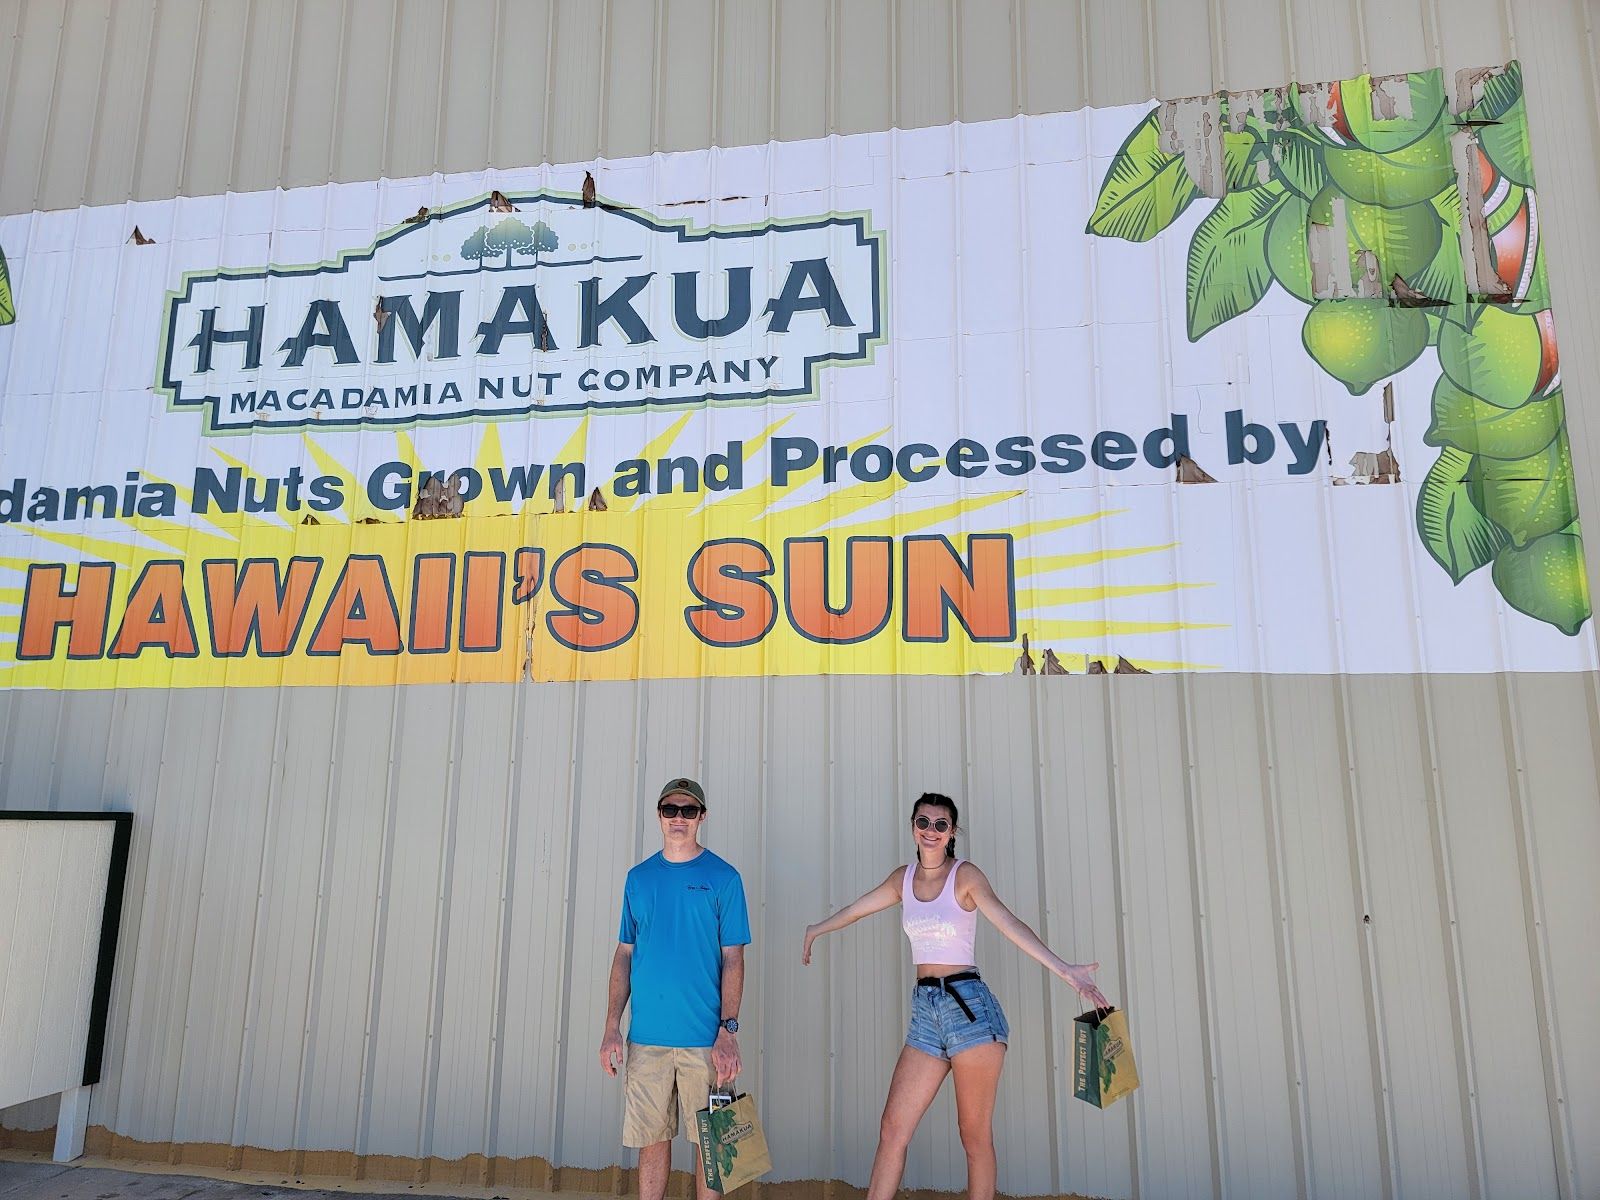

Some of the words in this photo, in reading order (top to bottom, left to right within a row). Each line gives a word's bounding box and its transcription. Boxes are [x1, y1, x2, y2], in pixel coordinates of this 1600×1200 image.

[188, 257, 853, 373] HAMAKUA
[229, 380, 462, 414] MACADAMIA
[478, 372, 563, 399] NUT
[576, 355, 779, 392] COMPANY
[191, 465, 345, 514] Nuts
[613, 440, 743, 498] and
[770, 413, 1191, 487] Processed
[1224, 408, 1328, 476] by
[684, 533, 1018, 648] SUN
[1078, 1029, 1087, 1044] NUT
[1078, 1047, 1087, 1075] PERFECT
[1078, 1076, 1086, 1091] THE
[701, 1119, 709, 1133] NUT
[722, 1123, 752, 1142] HAMAKUA
[703, 1136, 712, 1165] PERFECT
